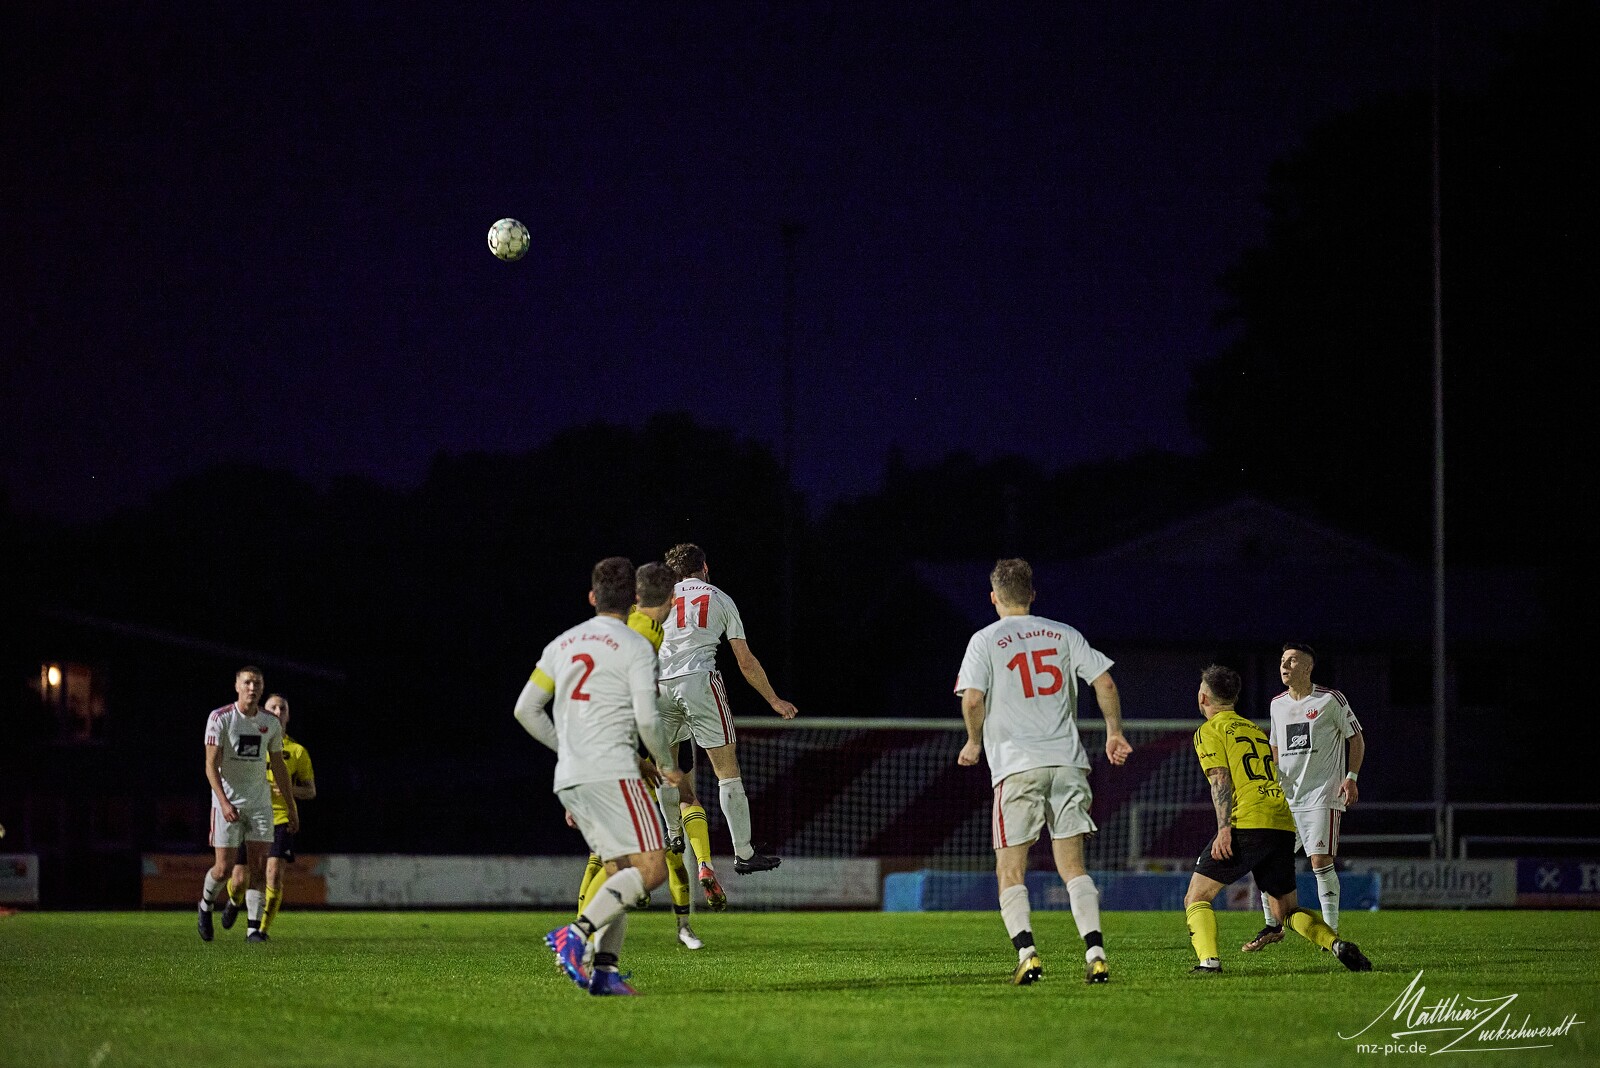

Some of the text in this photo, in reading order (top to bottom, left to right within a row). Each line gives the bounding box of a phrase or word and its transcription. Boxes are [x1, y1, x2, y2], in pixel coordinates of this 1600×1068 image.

[681, 585, 718, 595] Laufen
[674, 594, 711, 629] 11
[560, 633, 620, 651] SV Laufen
[997, 629, 1062, 649] SV Laufen
[570, 653, 595, 701] 2
[1006, 647, 1064, 699] 15
